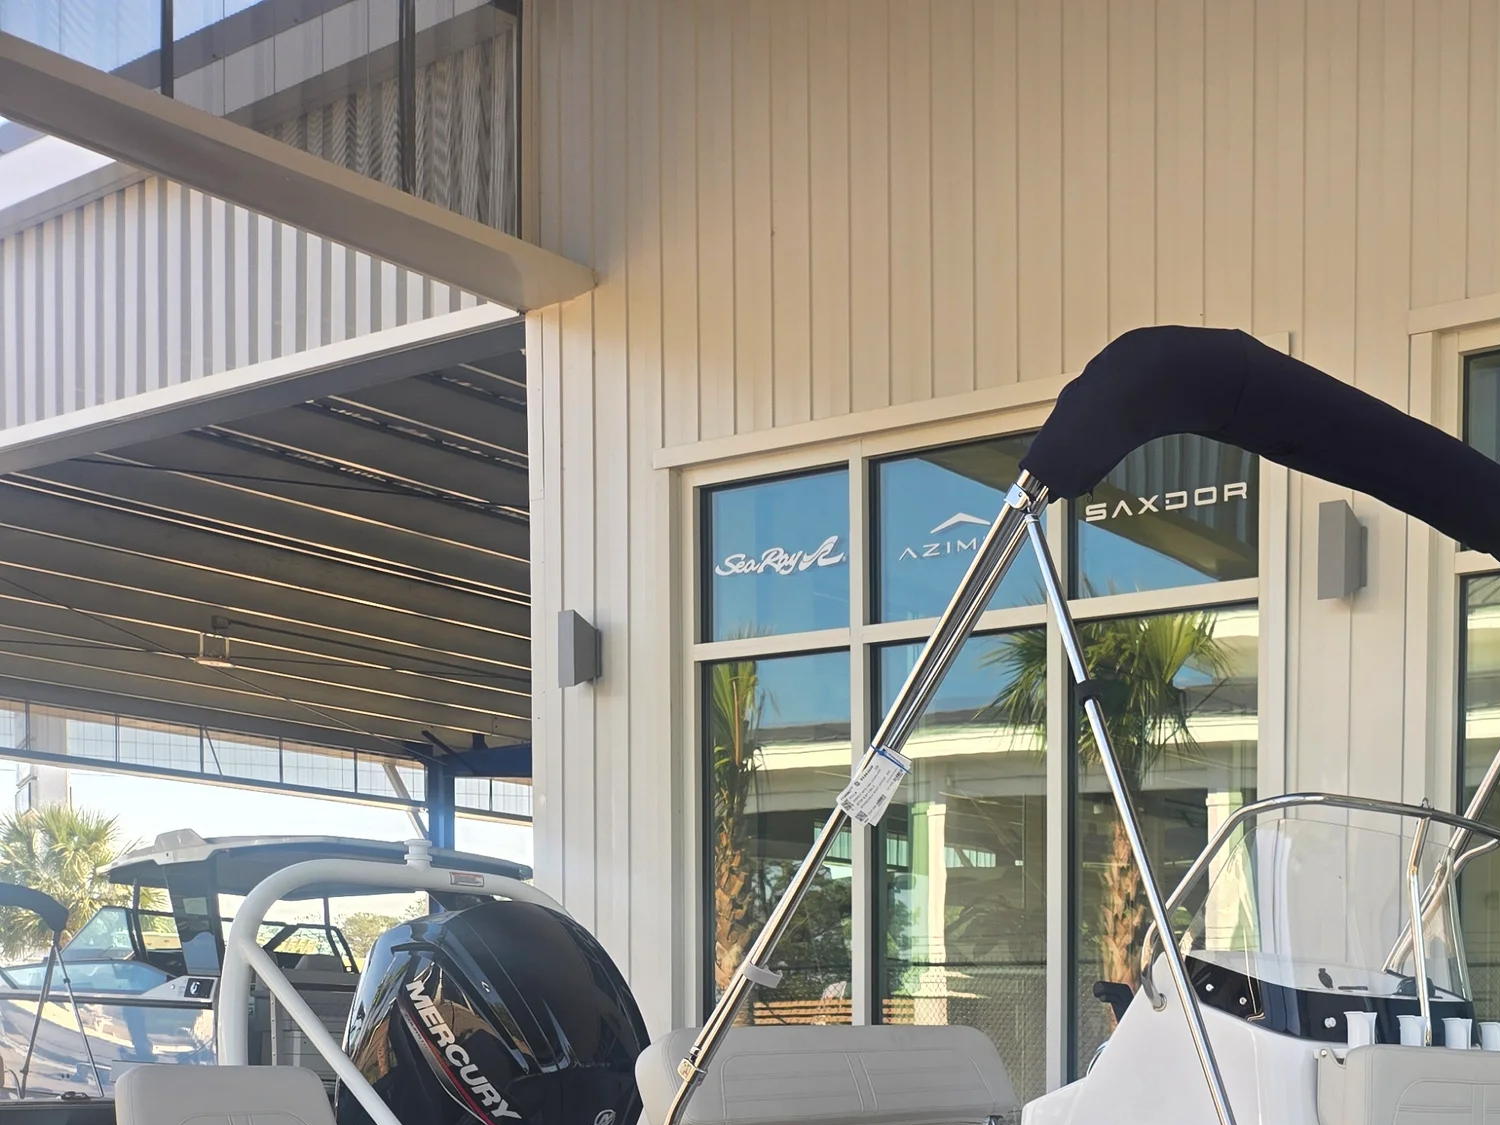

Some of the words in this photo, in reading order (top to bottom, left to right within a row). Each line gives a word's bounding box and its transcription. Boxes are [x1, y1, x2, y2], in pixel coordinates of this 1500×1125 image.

[1085, 481, 1248, 523] SAXDOR
[715, 553, 761, 576] Sea
[757, 547, 803, 575] Ray
[898, 536, 986, 561] AZIM
[405, 980, 523, 1120] MERCURY
